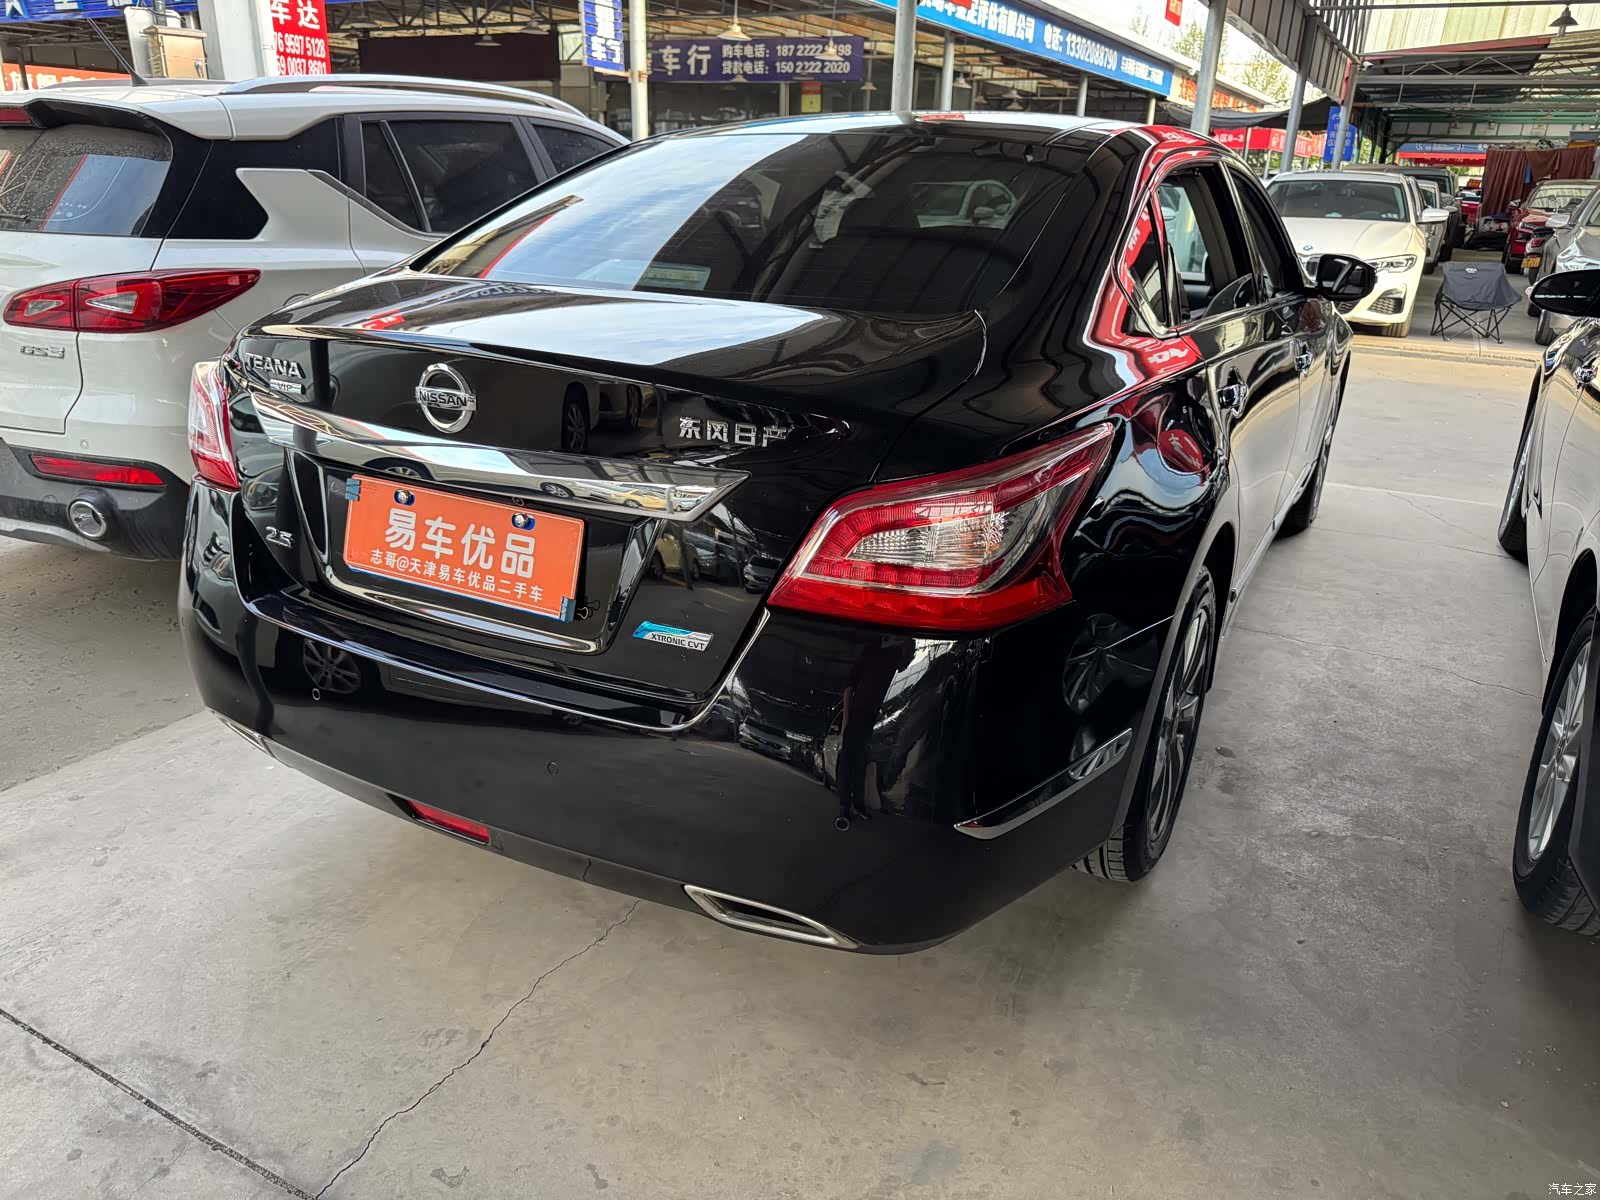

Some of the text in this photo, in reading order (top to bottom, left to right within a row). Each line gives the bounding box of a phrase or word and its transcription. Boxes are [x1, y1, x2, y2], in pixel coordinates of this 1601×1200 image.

[284, 32, 304, 55] 9597
[305, 36, 326, 58] 5128
[776, 44, 795, 57] 187
[796, 44, 823, 57] 2222
[824, 44, 852, 57] 98
[647, 44, 711, 75] 车行
[775, 61, 794, 73] 150
[795, 61, 822, 73] 2222
[823, 61, 851, 73] 2020
[20, 345, 65, 360] GS3
[245, 352, 303, 379] TEANA
[420, 390, 467, 407] NISSAN
[679, 417, 788, 448] 东风日产
[385, 507, 536, 579] 易车优品
[370, 548, 544, 603] 志哥@天津易车优品二手车
[651, 632, 705, 651] XTRONIC CVT
